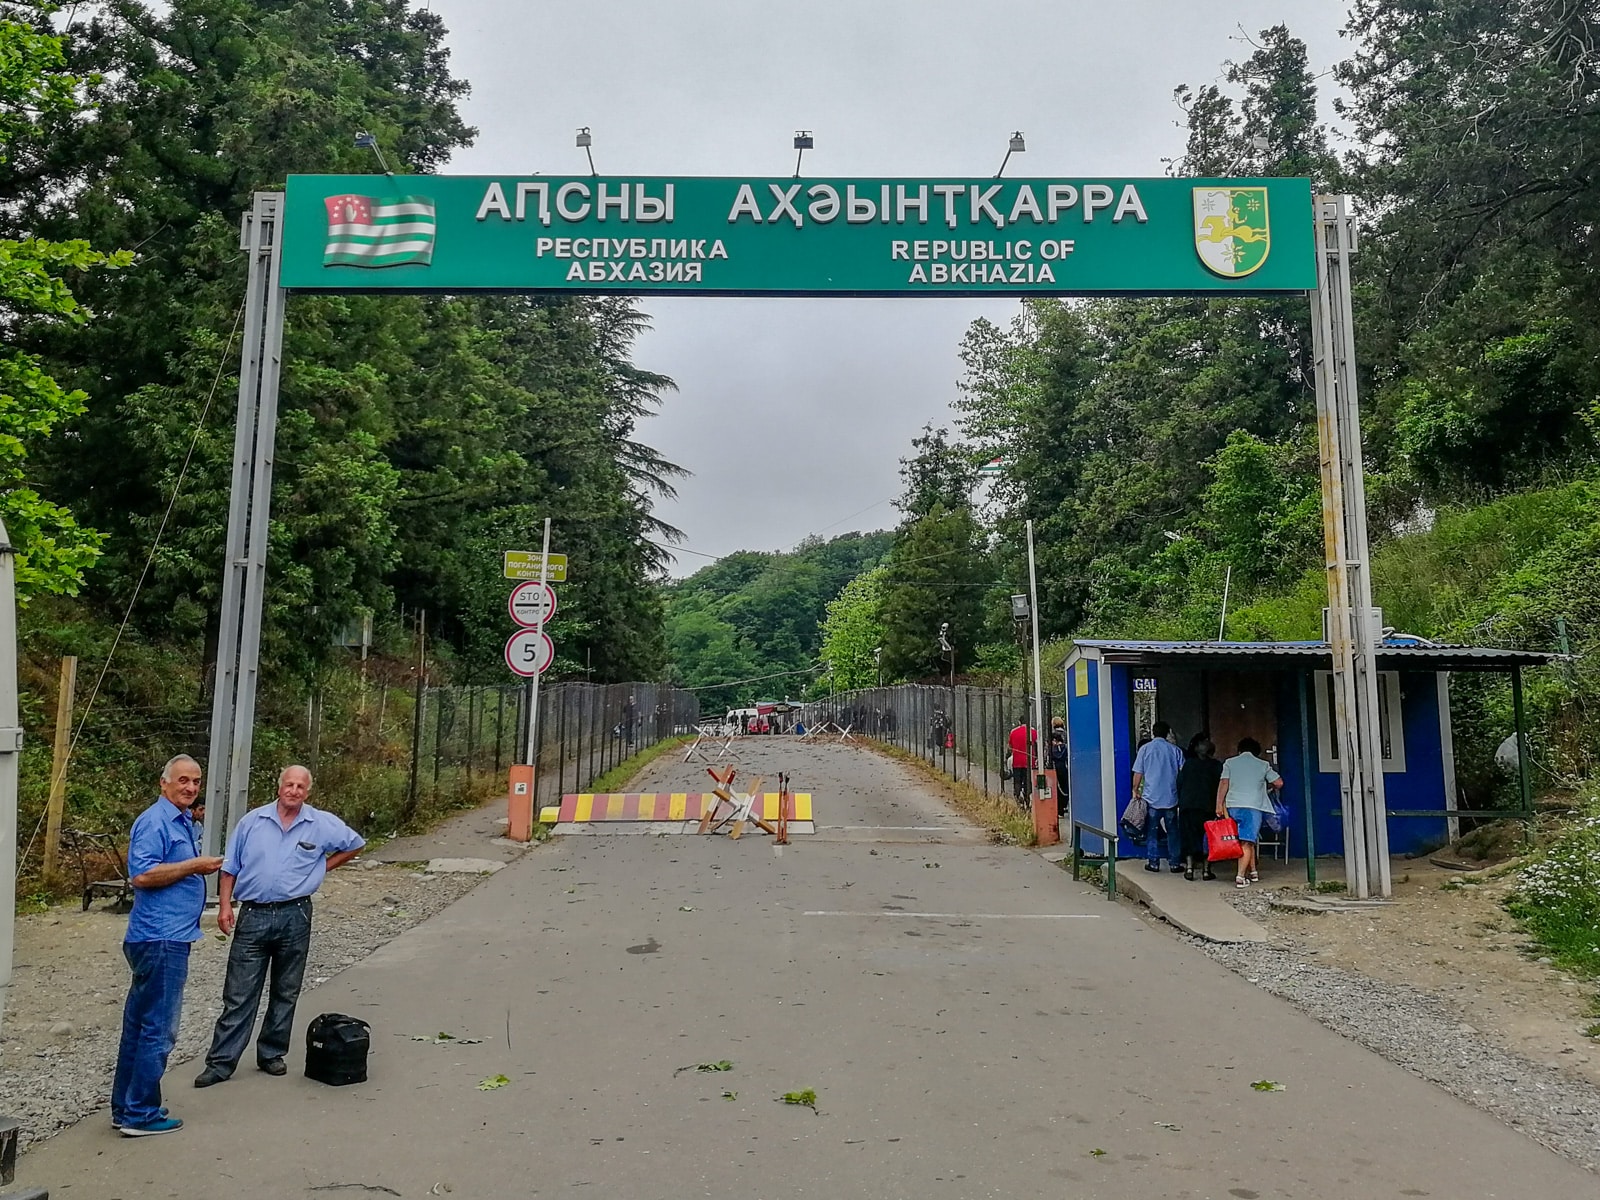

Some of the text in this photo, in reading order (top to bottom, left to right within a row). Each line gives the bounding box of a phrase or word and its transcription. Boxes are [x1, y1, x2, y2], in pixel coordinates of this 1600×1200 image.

[536, 237, 729, 259] РЕСПУБЛИКА
[891, 239, 1075, 261] REPUBLIC OF
[566, 261, 703, 283] АБХАЗИЯ
[908, 263, 1056, 284] ABKHAZIA
[508, 561, 564, 571] ПОГРАНИНОГО
[519, 592, 547, 601] STO
[523, 643, 536, 662] 5
